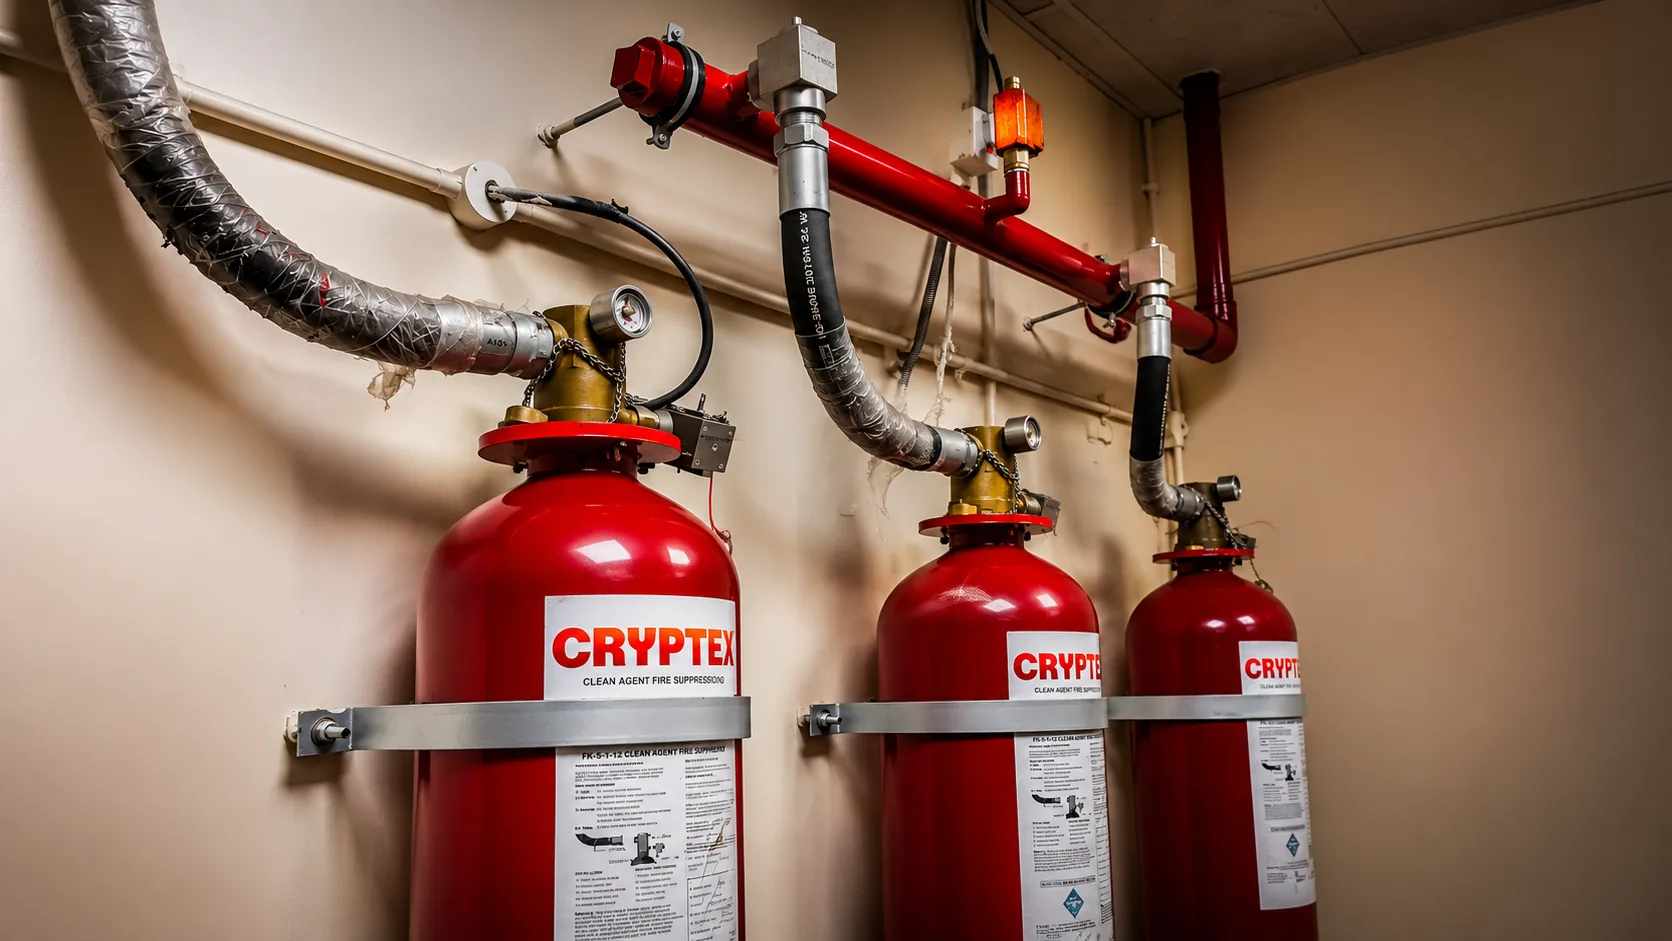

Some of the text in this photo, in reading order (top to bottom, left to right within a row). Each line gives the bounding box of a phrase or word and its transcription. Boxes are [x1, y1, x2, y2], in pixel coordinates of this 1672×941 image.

[552, 627, 734, 669] CRYPTEX
[583, 677, 616, 686] CLEAN
[618, 676, 650, 686] AGENT
[652, 676, 672, 685] FIRE
[624, 749, 651, 758] CLEAN
